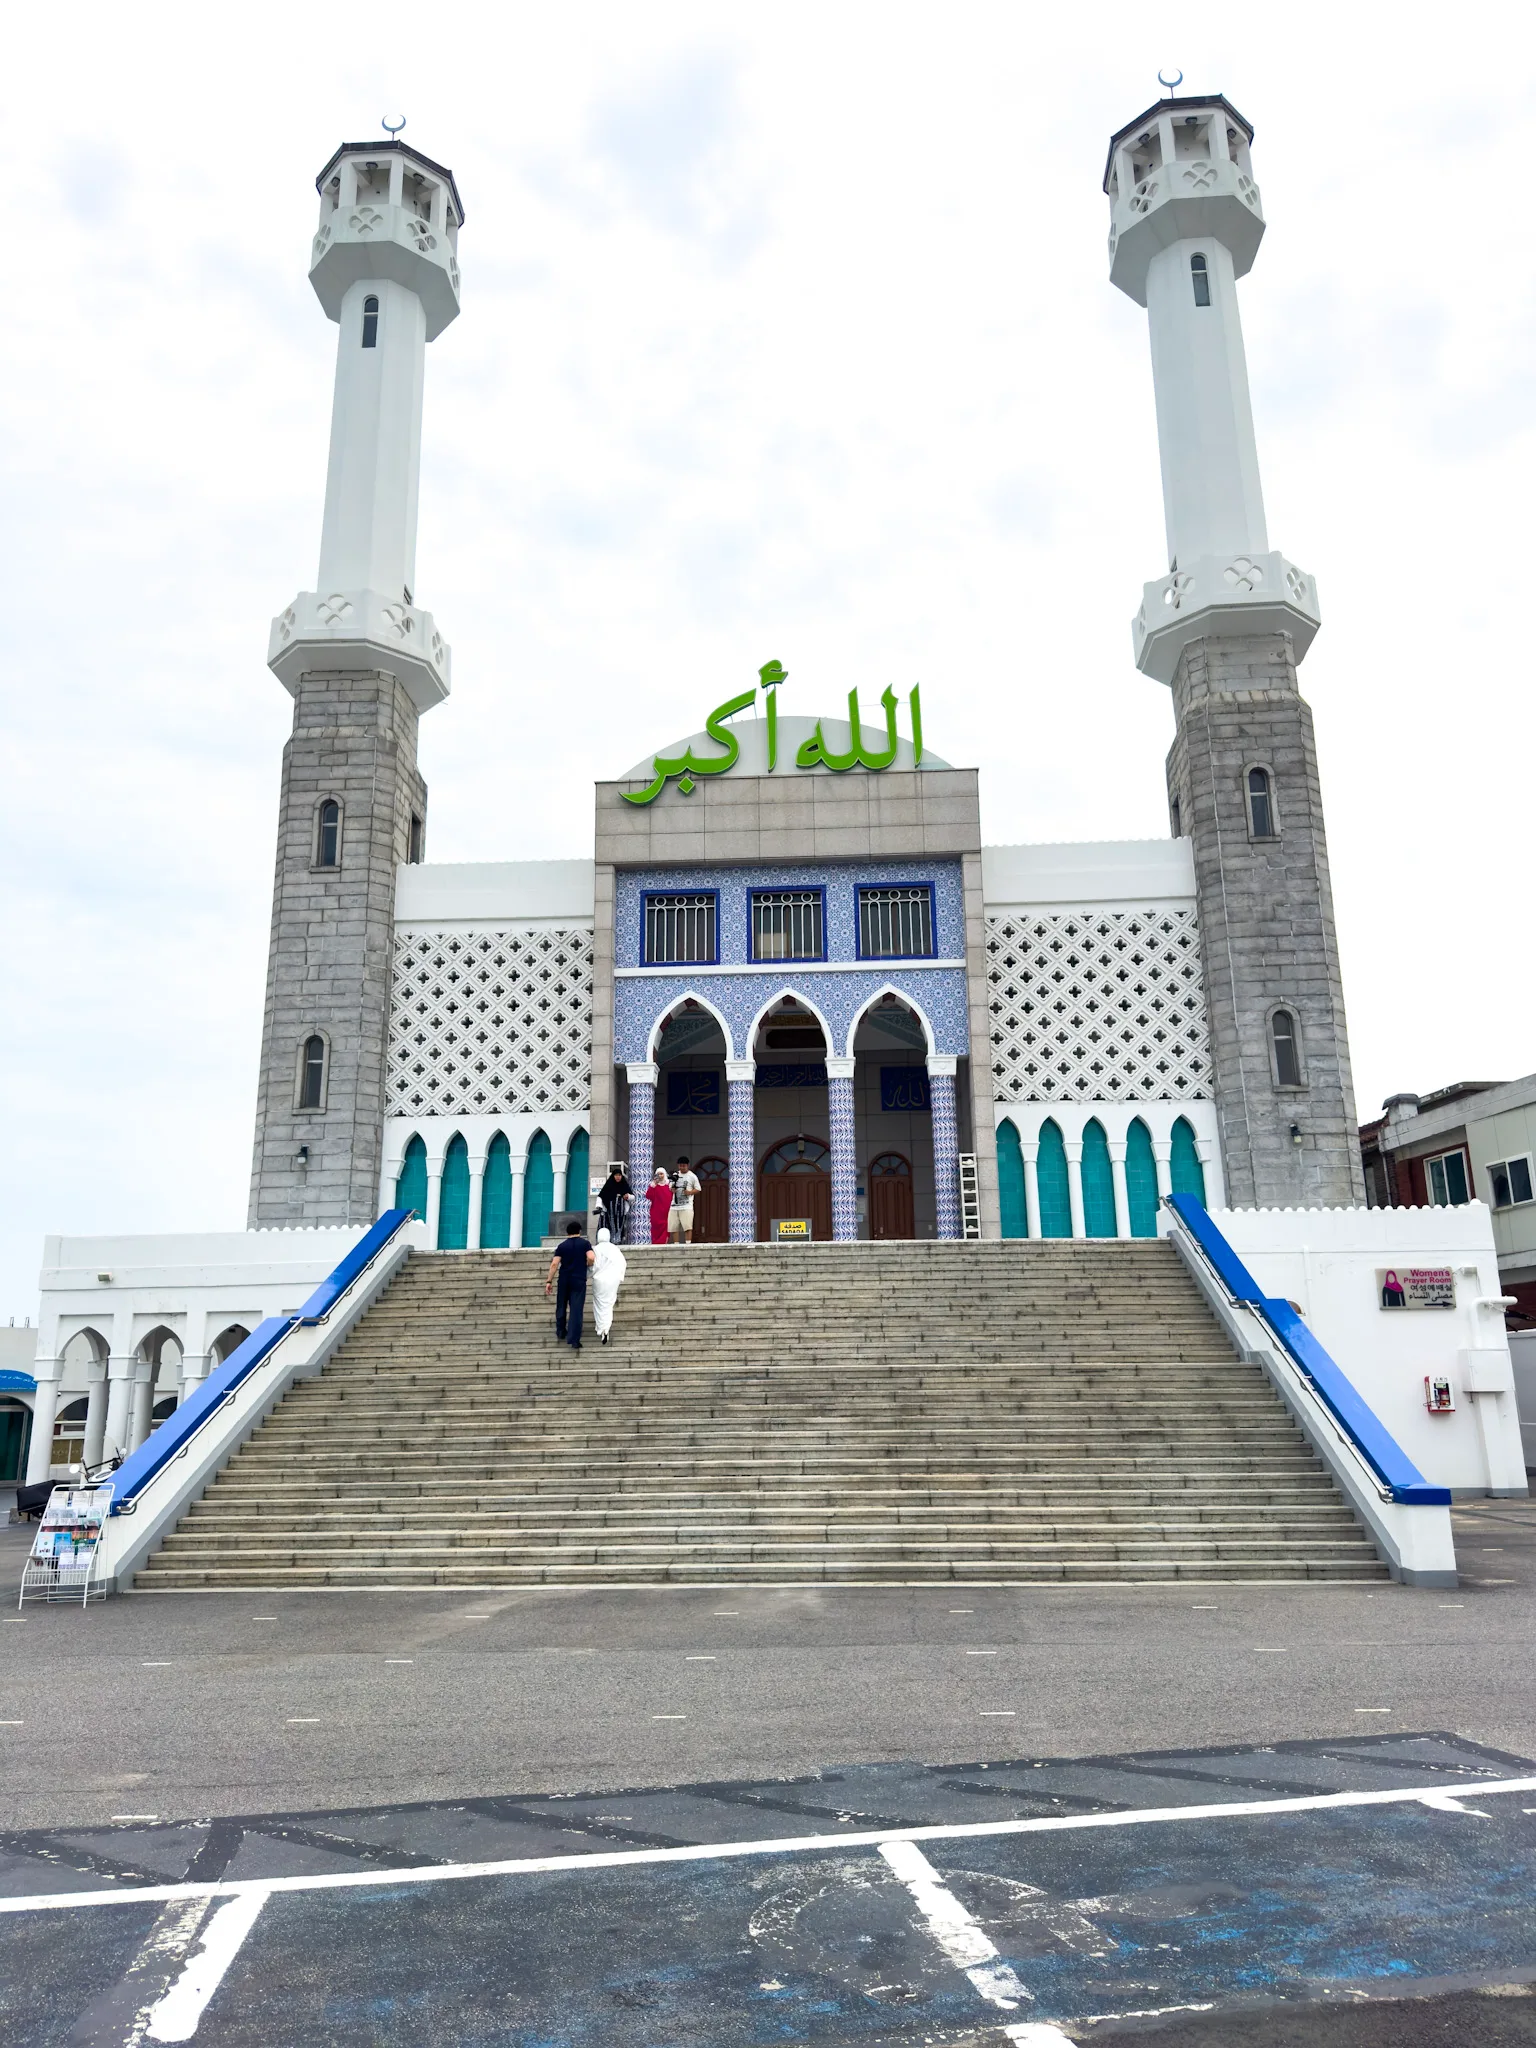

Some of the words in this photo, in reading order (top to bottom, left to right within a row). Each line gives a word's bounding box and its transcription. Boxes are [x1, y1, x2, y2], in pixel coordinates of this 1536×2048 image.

[617, 658, 789, 807] أكبر
[795, 681, 924, 773] الله
[1410, 1269, 1450, 1277] Women's
[1408, 1291, 1430, 1299] النساء
[1431, 1291, 1453, 1302] مصلى
